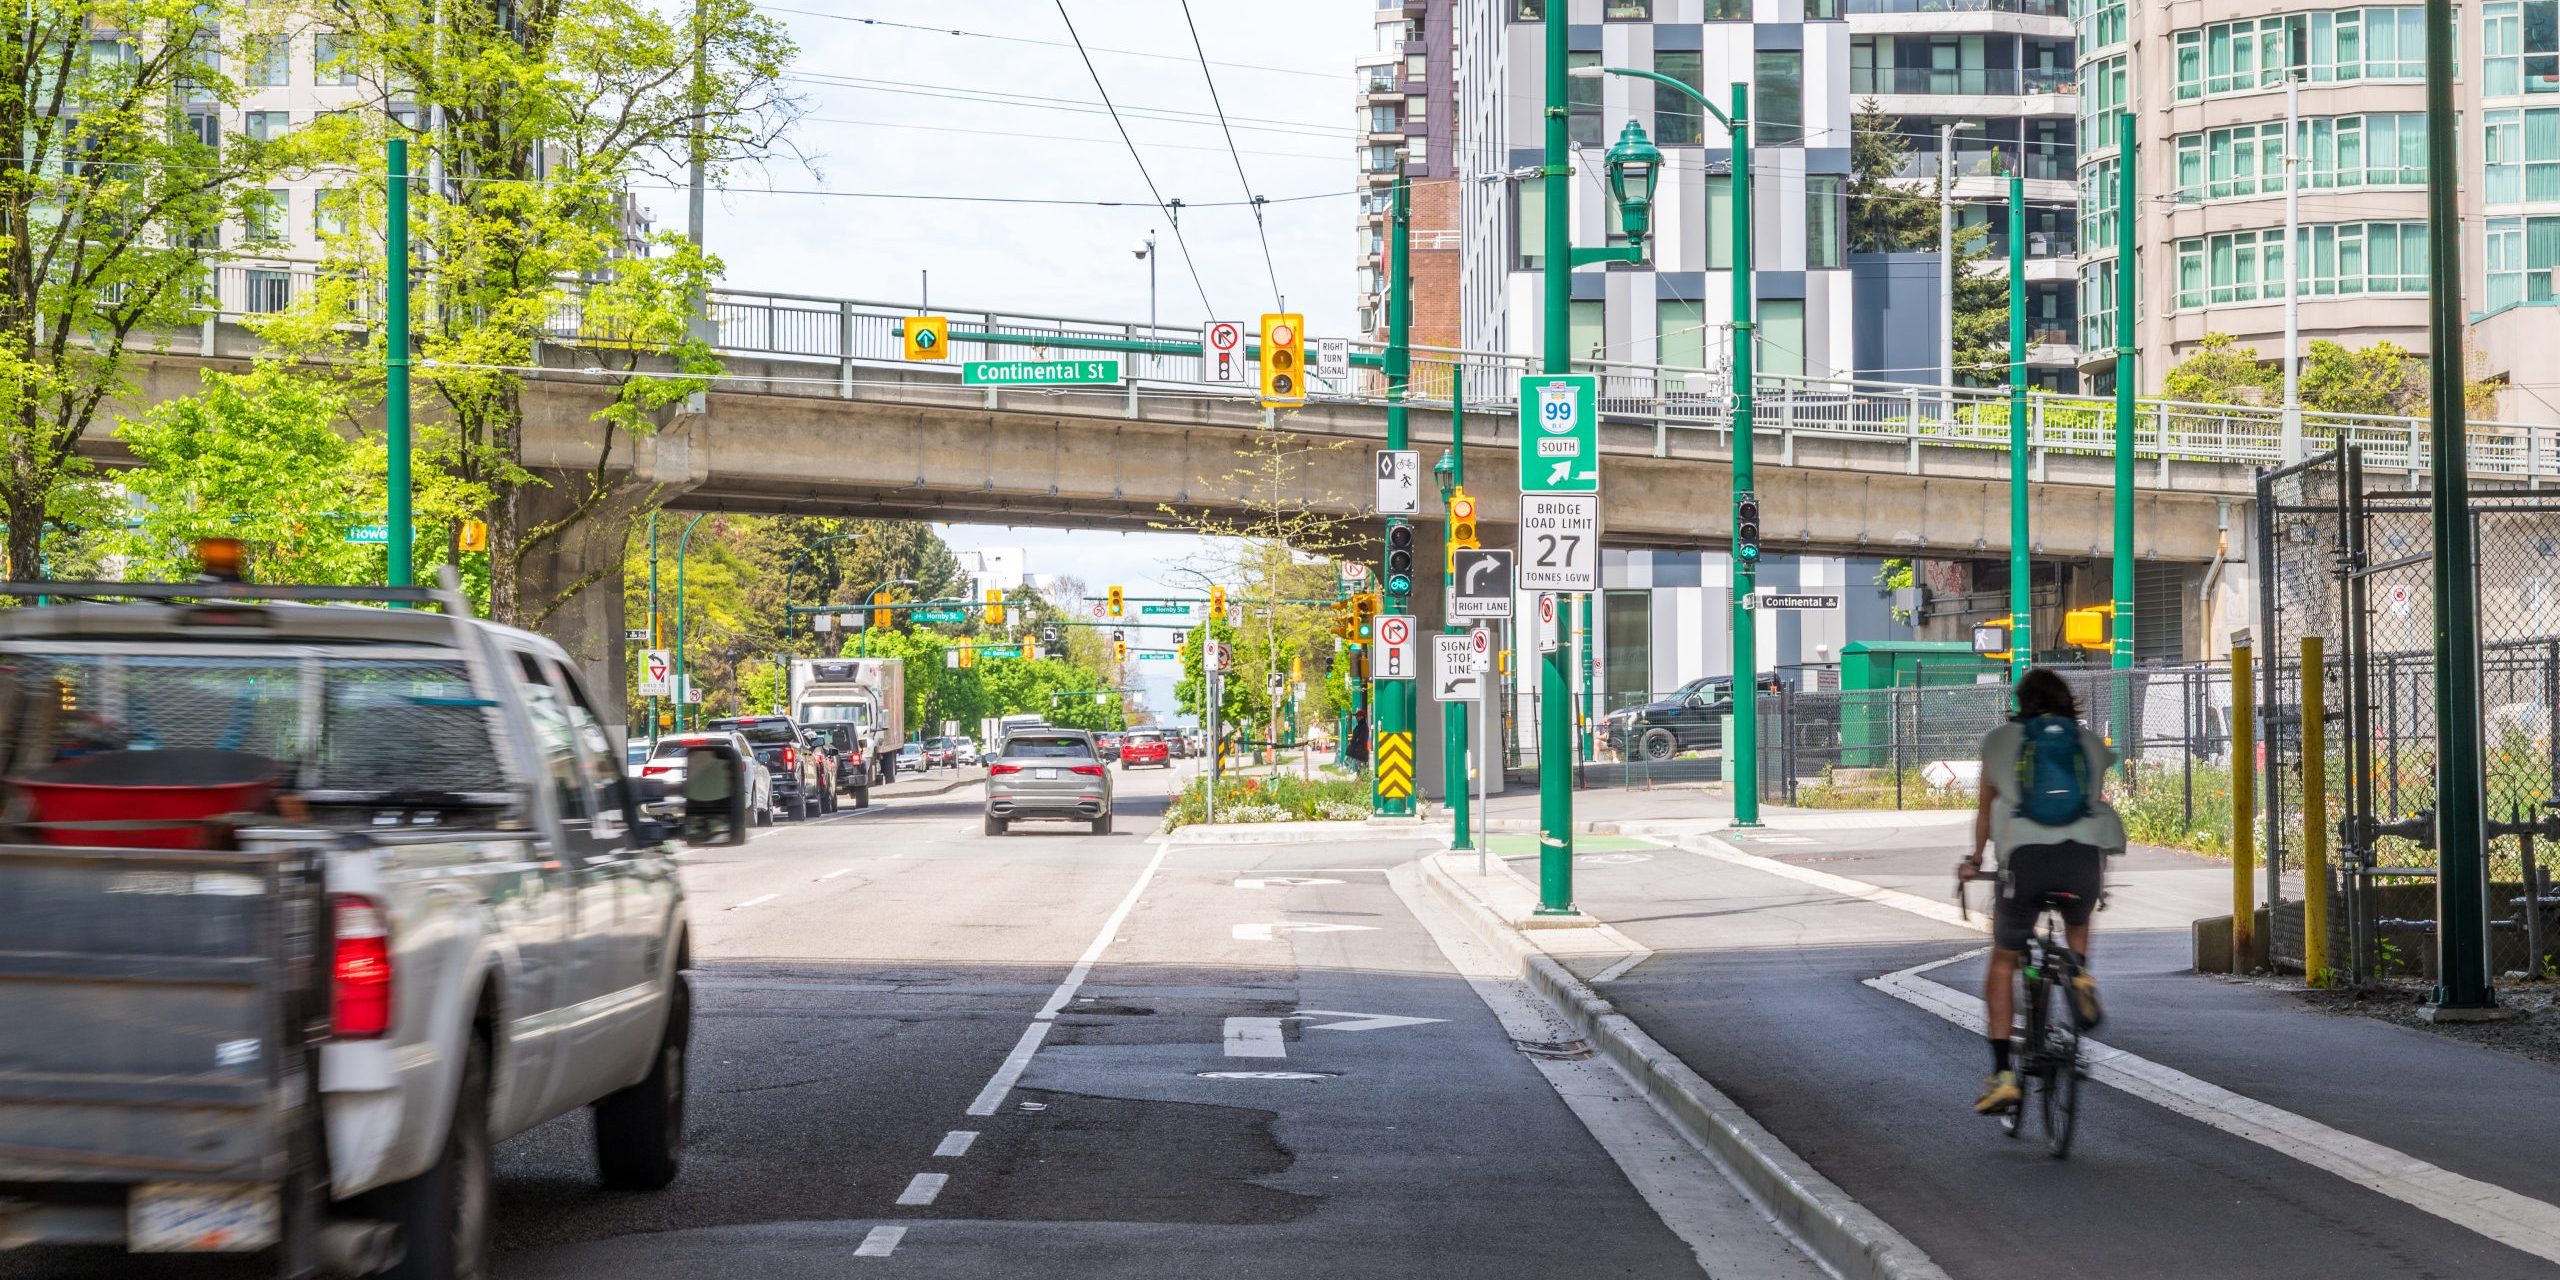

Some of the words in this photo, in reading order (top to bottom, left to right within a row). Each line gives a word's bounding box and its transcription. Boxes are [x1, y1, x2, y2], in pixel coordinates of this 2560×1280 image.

[1322, 342, 1344, 351] RIGHT
[1323, 354, 1342, 363] TURN
[977, 363, 1080, 380] Continental
[1088, 363, 1104, 379] St
[1320, 366, 1345, 375] SIGNAL
[1545, 402, 1571, 420] 99
[1541, 442, 1575, 452] SOUTH
[1537, 503, 1581, 514] BRIDGE
[1525, 517, 1556, 529] LOAD
[1562, 518, 1592, 529] LIMIT
[1536, 534, 1580, 568] 27
[1526, 572, 1561, 581] TONNES
[1565, 573, 1590, 582] LGVW
[1459, 602, 1483, 611] RIGHT
[1486, 602, 1508, 611] LANE
[1766, 597, 1822, 607] Continental
[927, 612, 948, 621] Hornby
[1441, 641, 1471, 652] SIGNA
[1449, 665, 1471, 674] LINE
